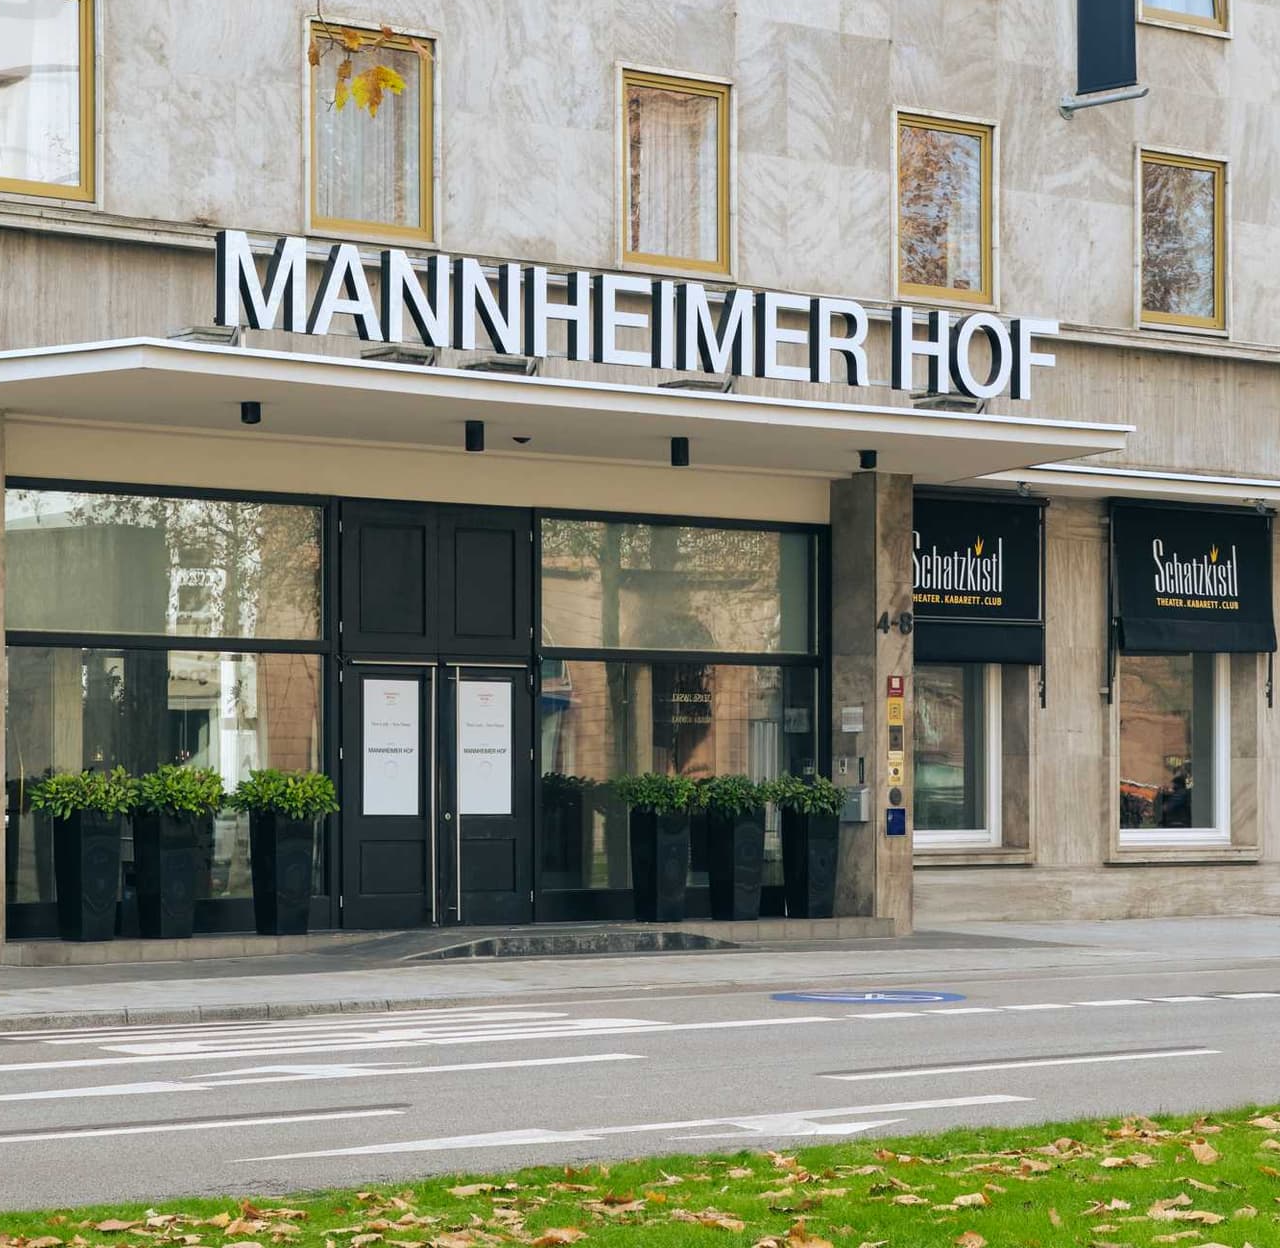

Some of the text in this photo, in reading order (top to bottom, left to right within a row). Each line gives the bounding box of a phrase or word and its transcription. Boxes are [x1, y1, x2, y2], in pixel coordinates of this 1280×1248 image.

[215, 230, 1060, 401] MANNHEIMER HOF
[912, 530, 1002, 593] Schatzkistl
[1152, 538, 1238, 597] Schatzkistl
[984, 596, 1003, 607] CLUB
[1222, 600, 1239, 610] CLUB
[877, 611, 913, 634] 4-8
